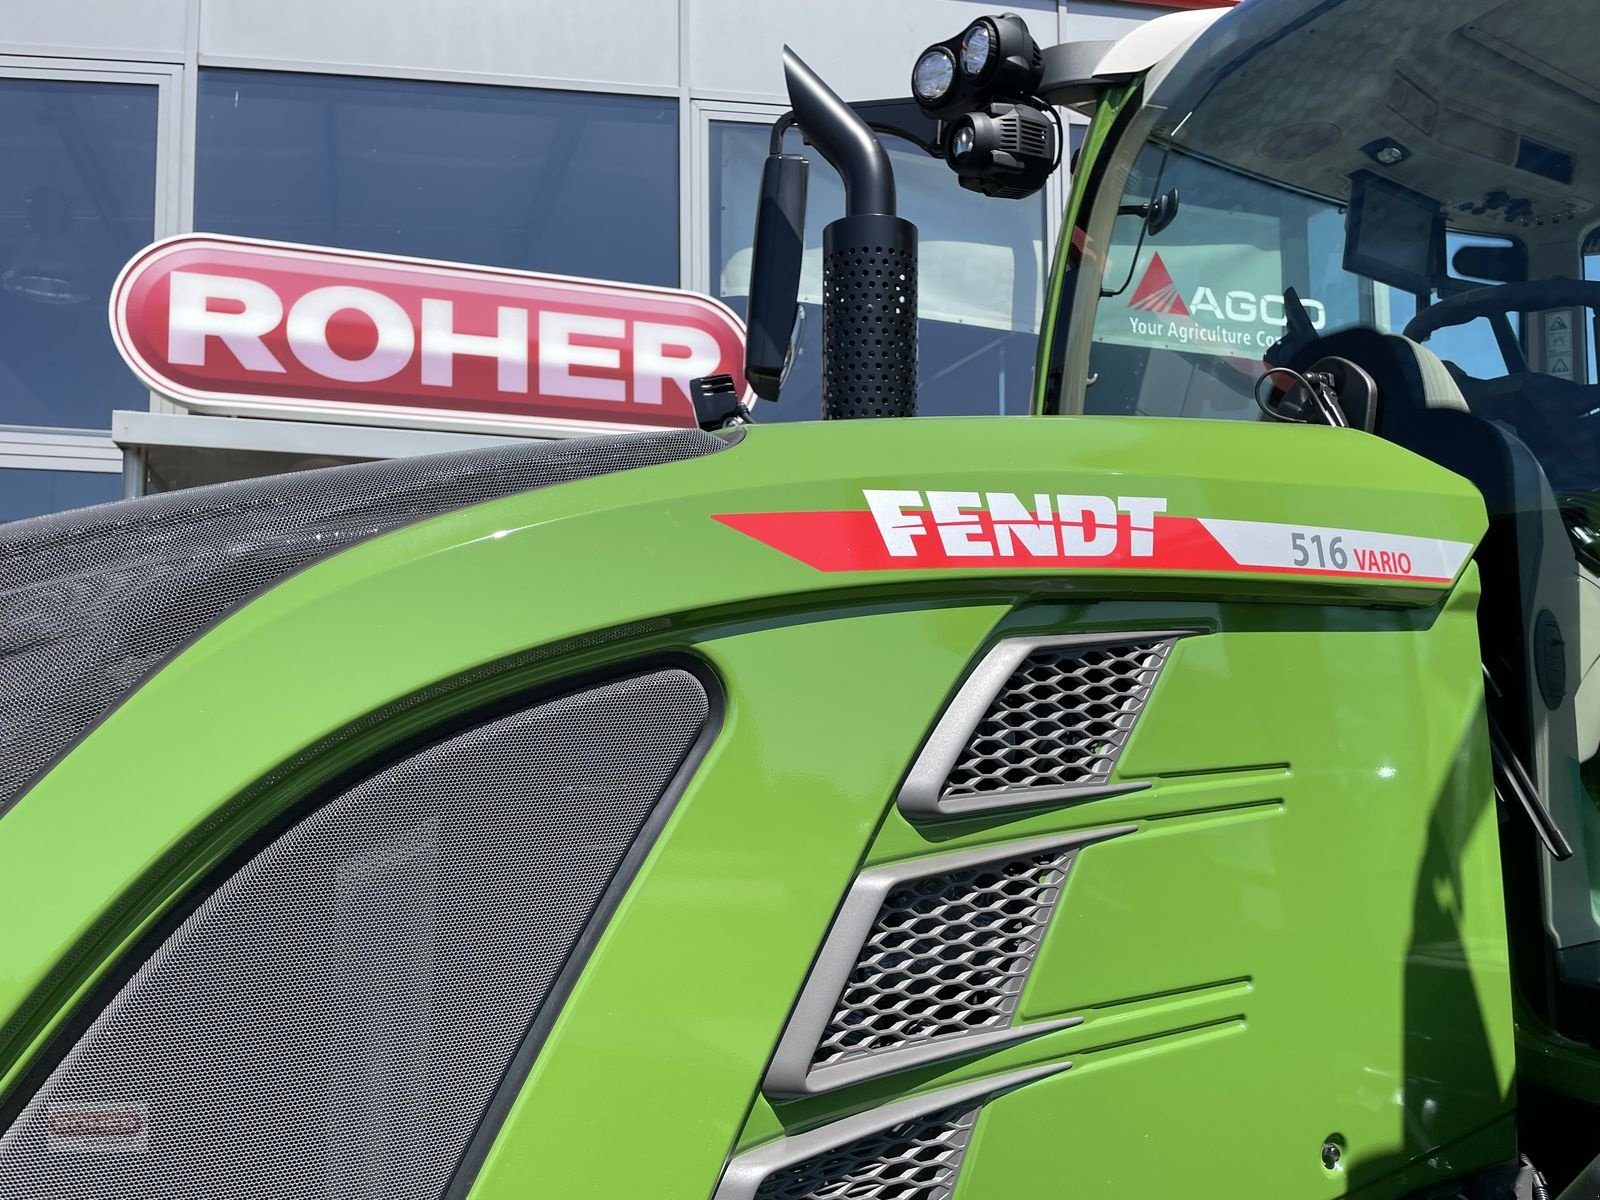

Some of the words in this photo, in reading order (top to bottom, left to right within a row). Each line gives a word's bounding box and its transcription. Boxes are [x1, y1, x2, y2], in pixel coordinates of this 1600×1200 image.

[168, 272, 721, 404] ROHER
[1130, 317, 1163, 337] Your
[1168, 323, 1251, 346] Agriculture
[862, 489, 1167, 557] FENDT
[1291, 532, 1348, 570] 516
[1353, 548, 1412, 574] VARIO
